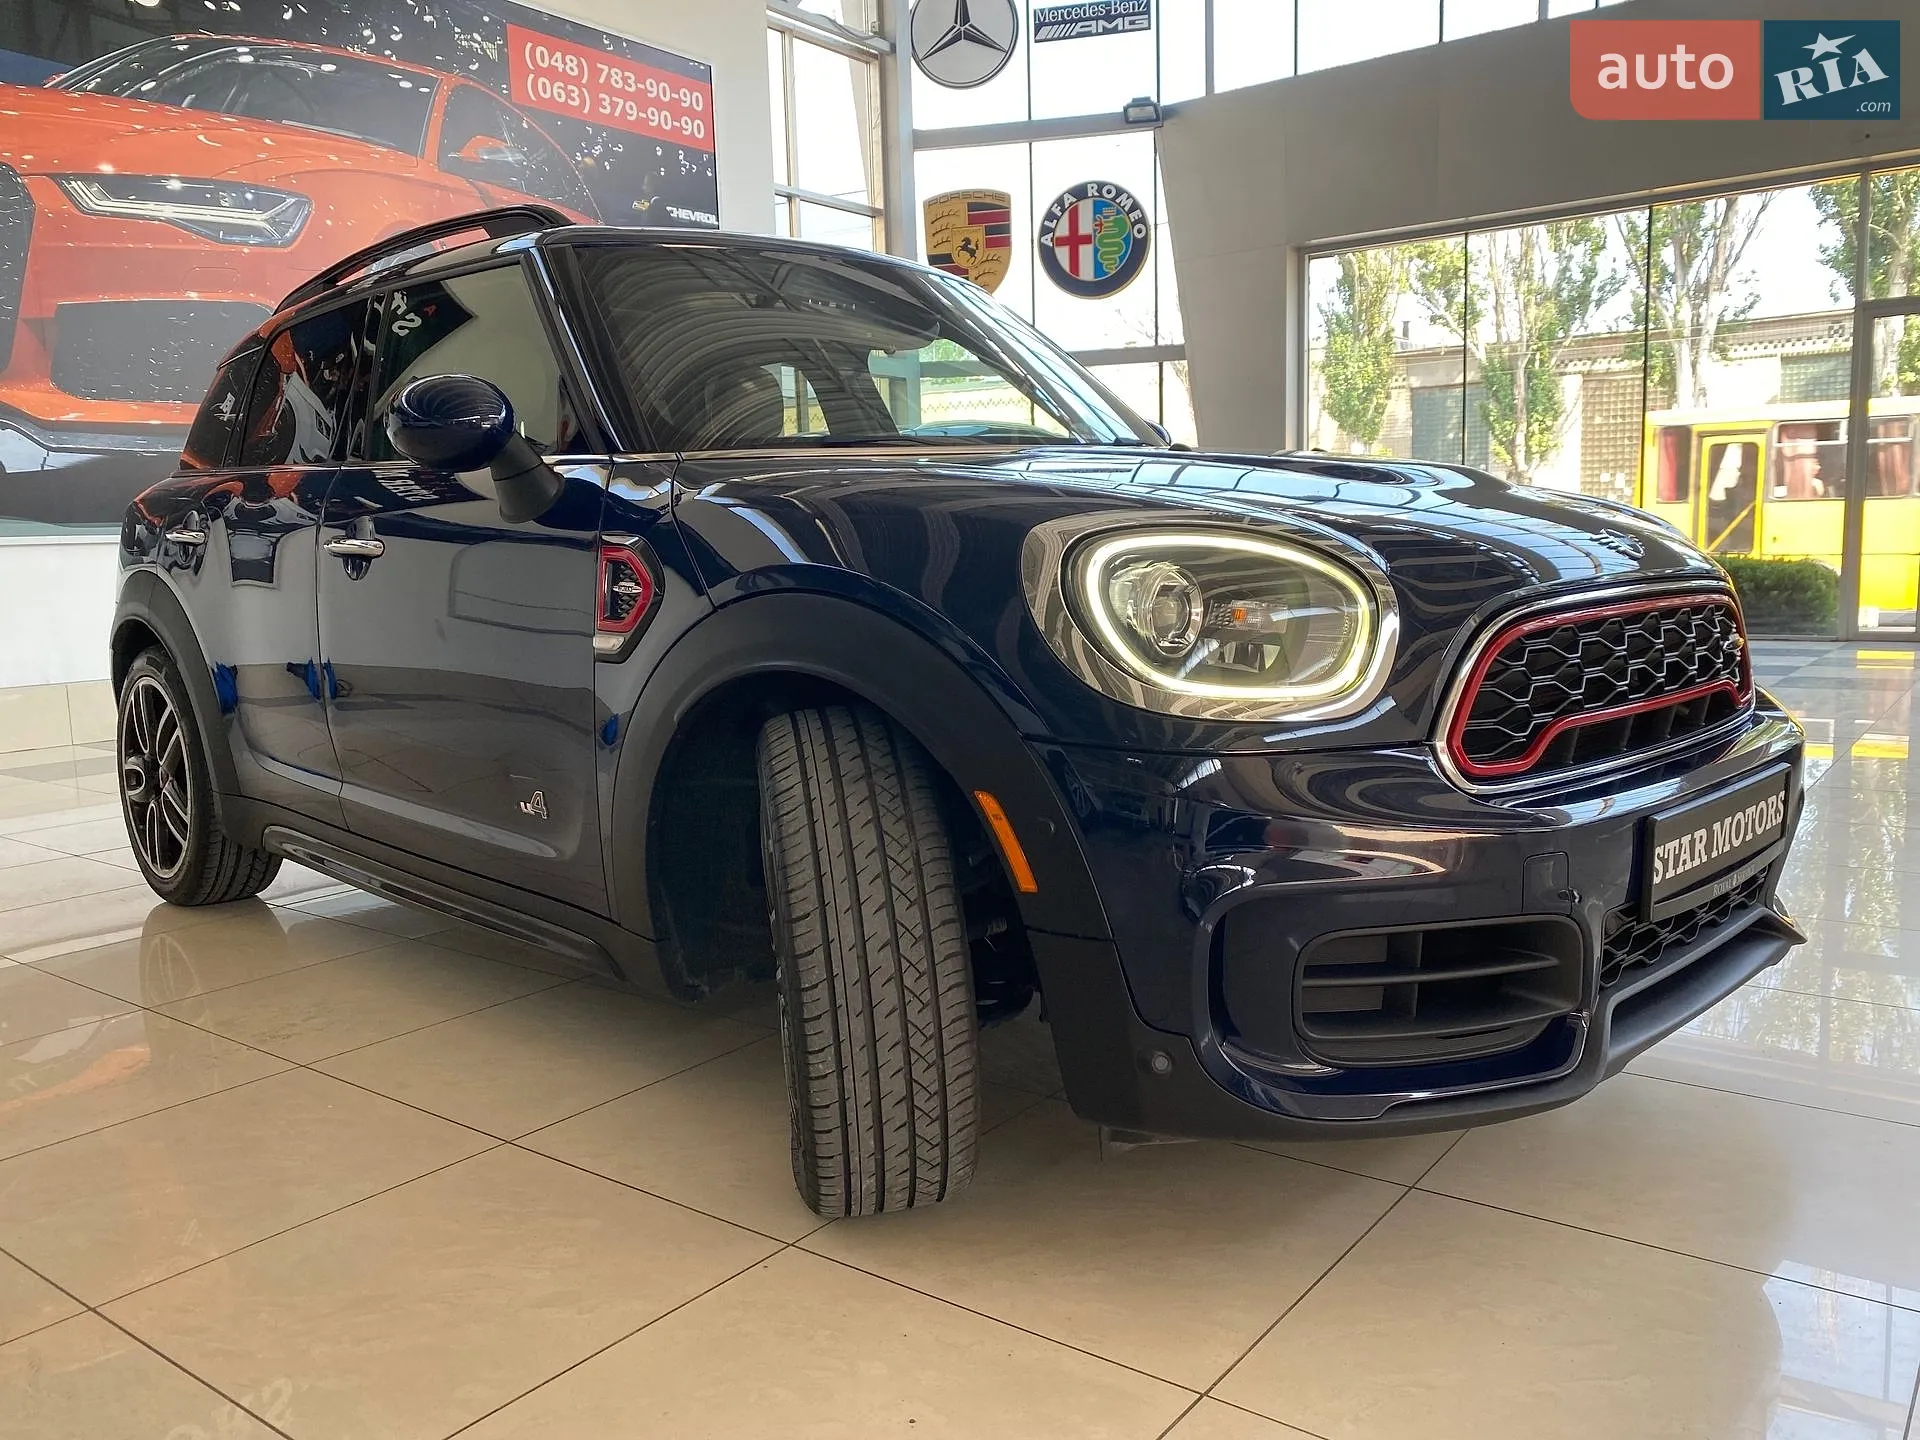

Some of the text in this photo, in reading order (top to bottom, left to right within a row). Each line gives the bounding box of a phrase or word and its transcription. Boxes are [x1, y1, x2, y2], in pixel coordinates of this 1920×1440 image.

[1035, 0, 1148, 23] Mercedes-Benz
[524, 42, 704, 111] (048) 783-90-90
[526, 73, 705, 139] (063) 379-90-90
[1040, 182, 1147, 247] ALFA ROMEO
[1653, 790, 1786, 885] STAR MOTORS
